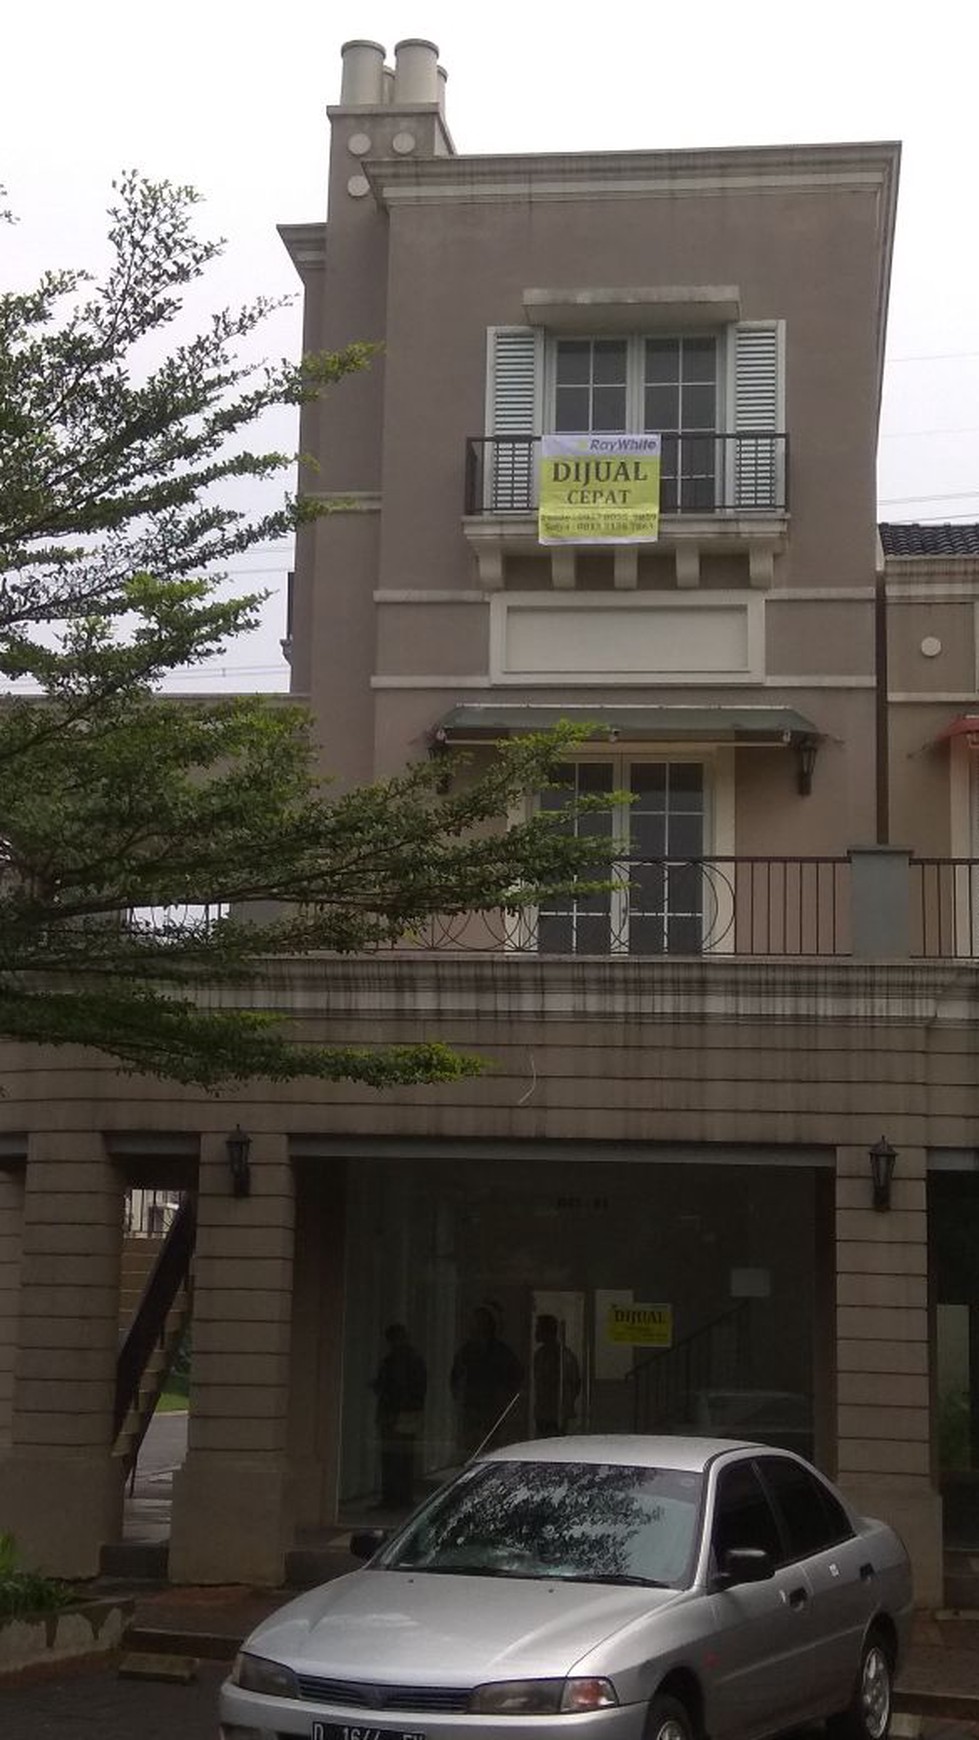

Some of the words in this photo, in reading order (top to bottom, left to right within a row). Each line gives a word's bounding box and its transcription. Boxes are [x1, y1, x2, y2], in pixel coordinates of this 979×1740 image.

[552, 461, 648, 487] DIJUAL
[567, 489, 631, 505] CEPAT
[614, 1309, 666, 1326] DIJUAL
